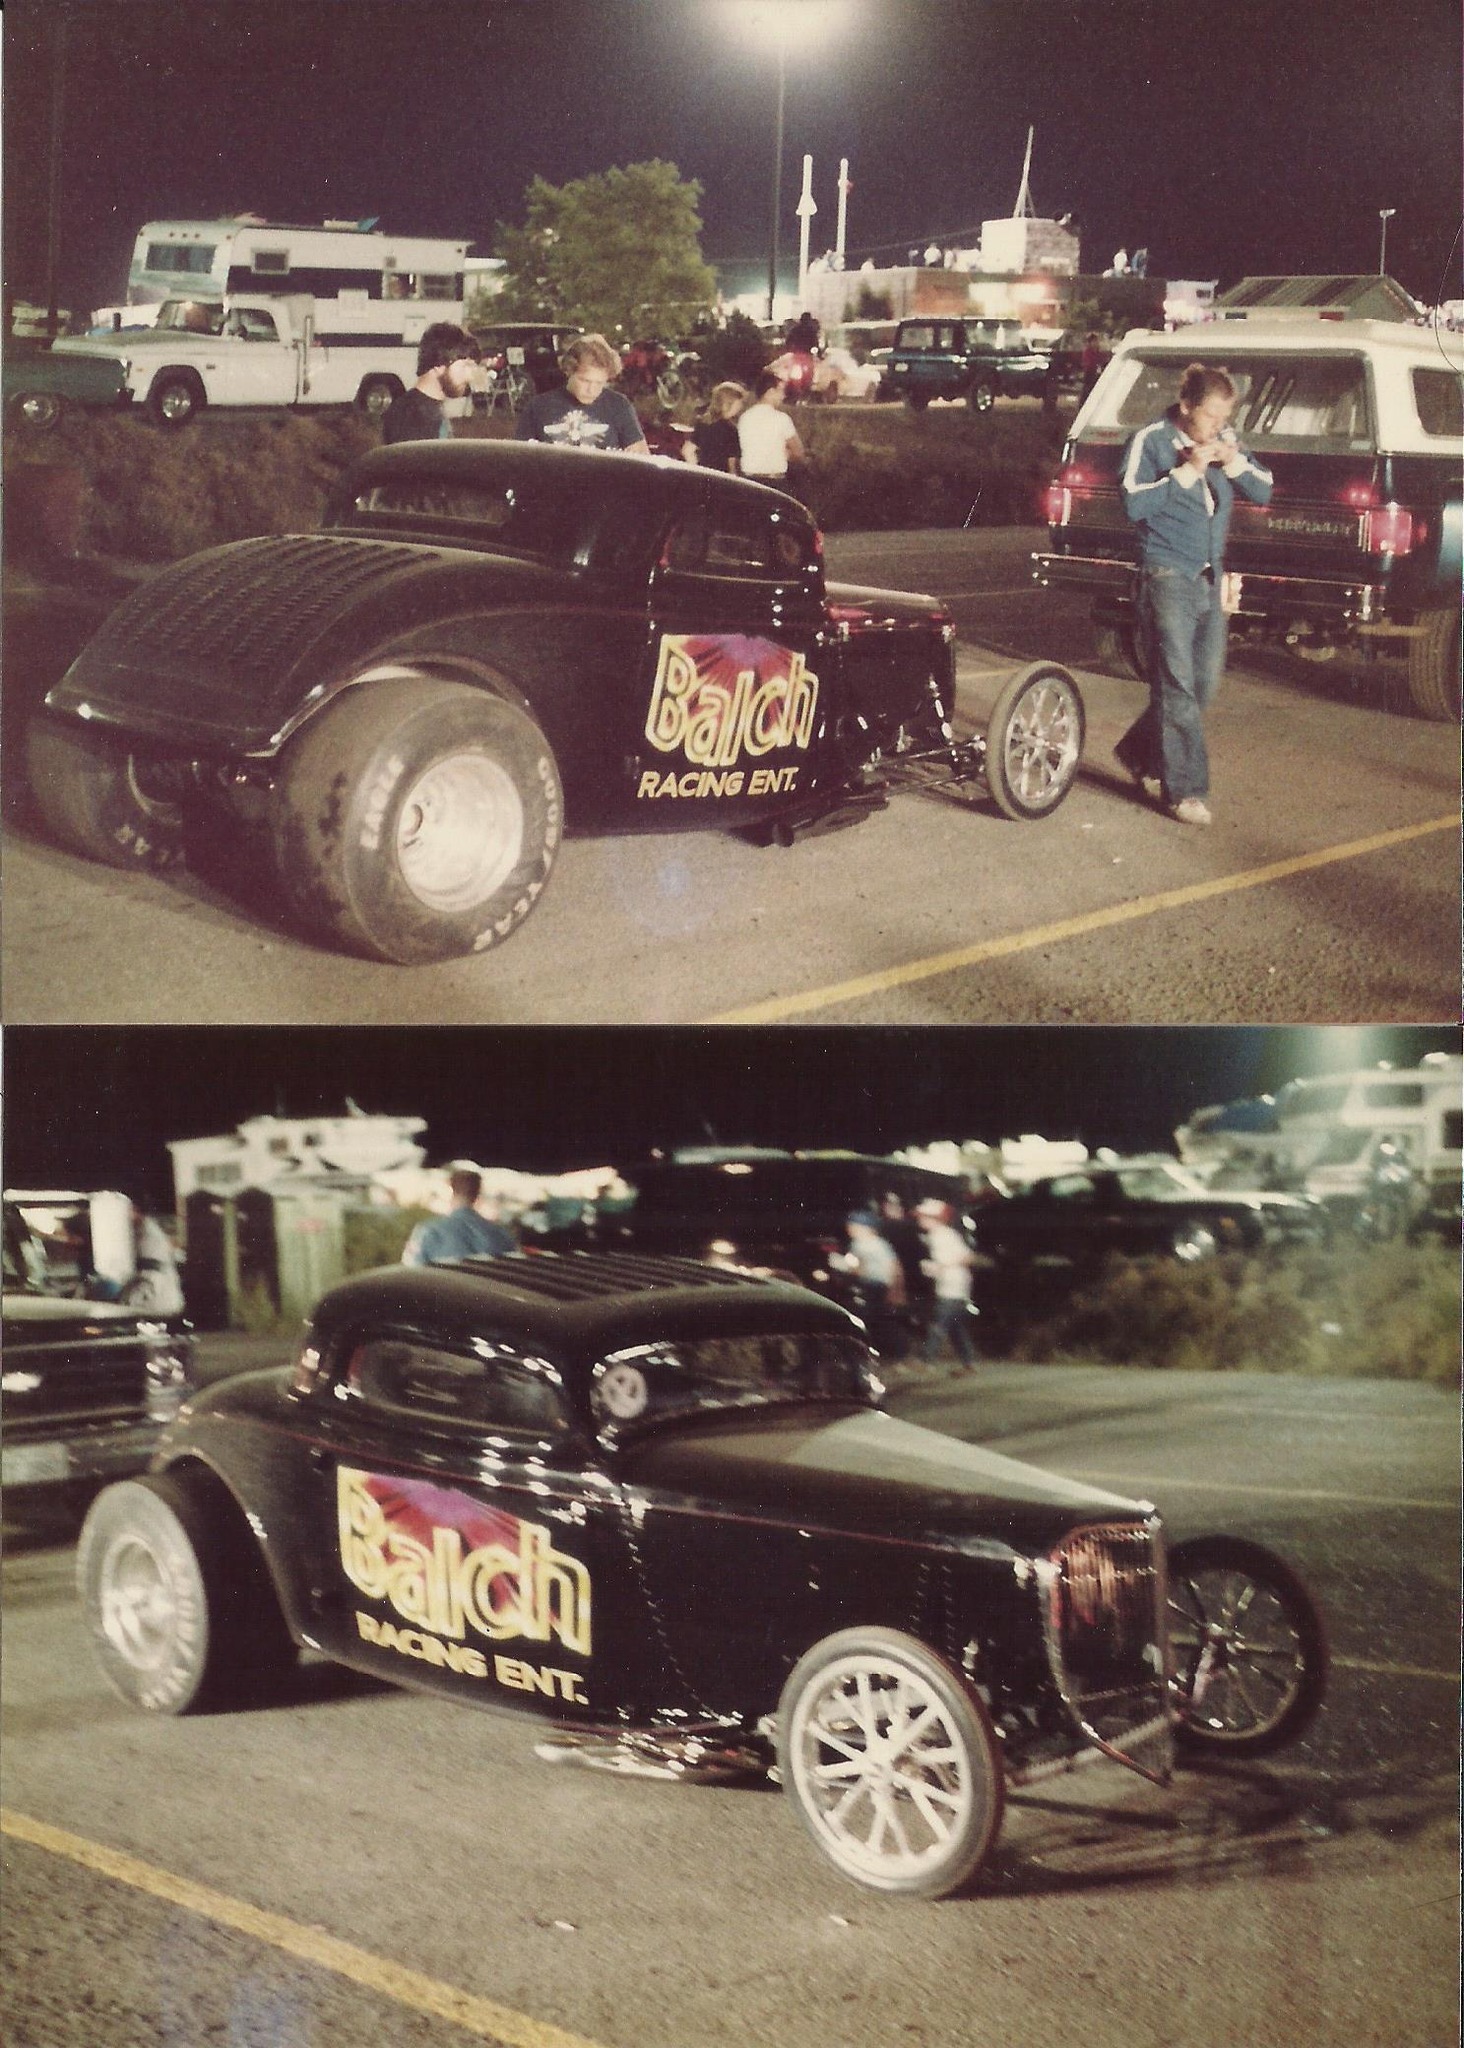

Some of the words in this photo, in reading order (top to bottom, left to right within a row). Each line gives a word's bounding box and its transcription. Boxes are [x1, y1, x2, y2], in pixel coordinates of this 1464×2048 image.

[645, 633, 819, 767] Balch
[637, 771, 745, 798] RACING
[747, 767, 799, 795] ENT.
[337, 1465, 592, 1656] Balch
[356, 1611, 488, 1677] RACING
[494, 1654, 589, 1705] ENT.
